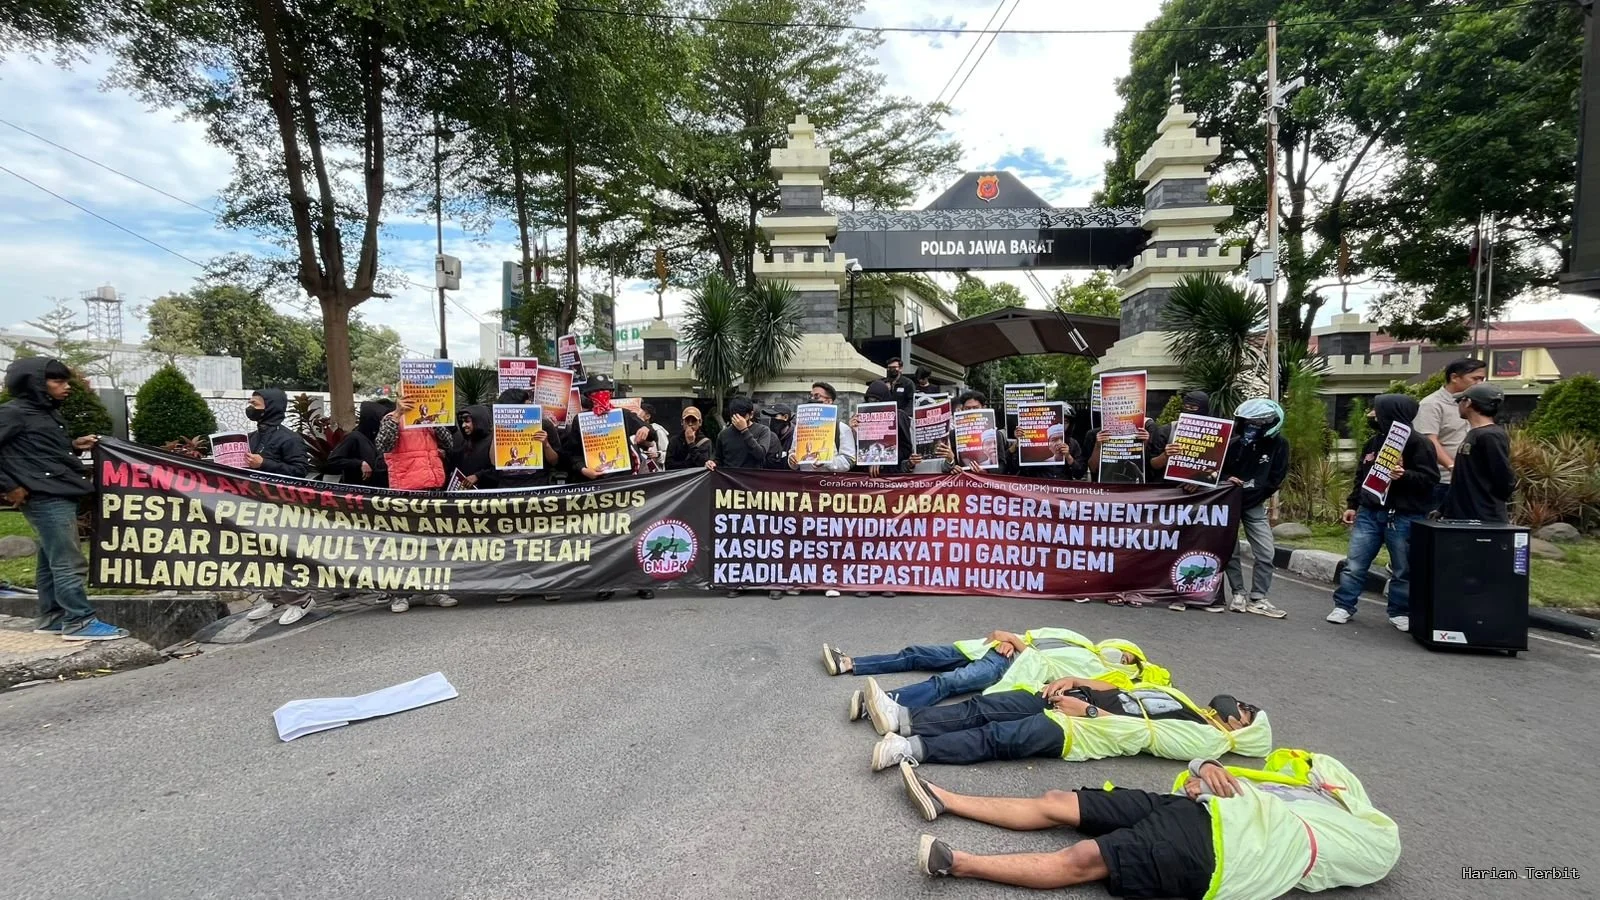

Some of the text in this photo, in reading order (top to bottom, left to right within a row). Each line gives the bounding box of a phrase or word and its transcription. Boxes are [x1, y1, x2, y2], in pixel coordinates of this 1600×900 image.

[921, 239, 1054, 255] POLDA JAWA BARAT
[1201, 427, 1219, 436] ATAS
[1202, 434, 1224, 443] PESTA
[1176, 461, 1201, 471] TEMPAT
[1195, 459, 1217, 468] JALAN
[101, 460, 257, 498] MENOLAK
[260, 481, 340, 509] LUPA
[370, 496, 450, 514] USUT
[455, 495, 563, 514] TUNTAS
[565, 489, 647, 513] KASUS
[819, 479, 858, 488] Gerakan
[860, 480, 909, 488] Mahasiswa
[910, 479, 934, 488] Jabar
[936, 479, 963, 488] Peduli
[965, 480, 1006, 490] Keadilan
[1009, 481, 1050, 495] (GMJPK)
[1052, 485, 1105, 497] menuntut
[102, 493, 632, 535] PESTA PERNIKAHAN ANAK GUBERNUR
[714, 489, 1230, 531] MEMINTA POLDA JABAR SEGERA MENENTUKAN
[100, 526, 592, 562] JABAR DEDI MULYADI YANG TELAH
[714, 513, 1181, 551] STATUS PENYIDIKAN PENANGANAN HUKUM
[643, 559, 688, 574] GMJPK
[714, 538, 784, 560] KASUS
[789, 539, 856, 561] PESTA
[861, 541, 944, 562] RAKYAT
[949, 542, 970, 564] DI
[975, 543, 1051, 569] GARUT
[1056, 548, 1115, 573] DEMI
[99, 557, 452, 592] HILANGKAN 3 NYAWA!!!
[714, 563, 1045, 592] KEADILAN & KEPASTIAN HUKUM
